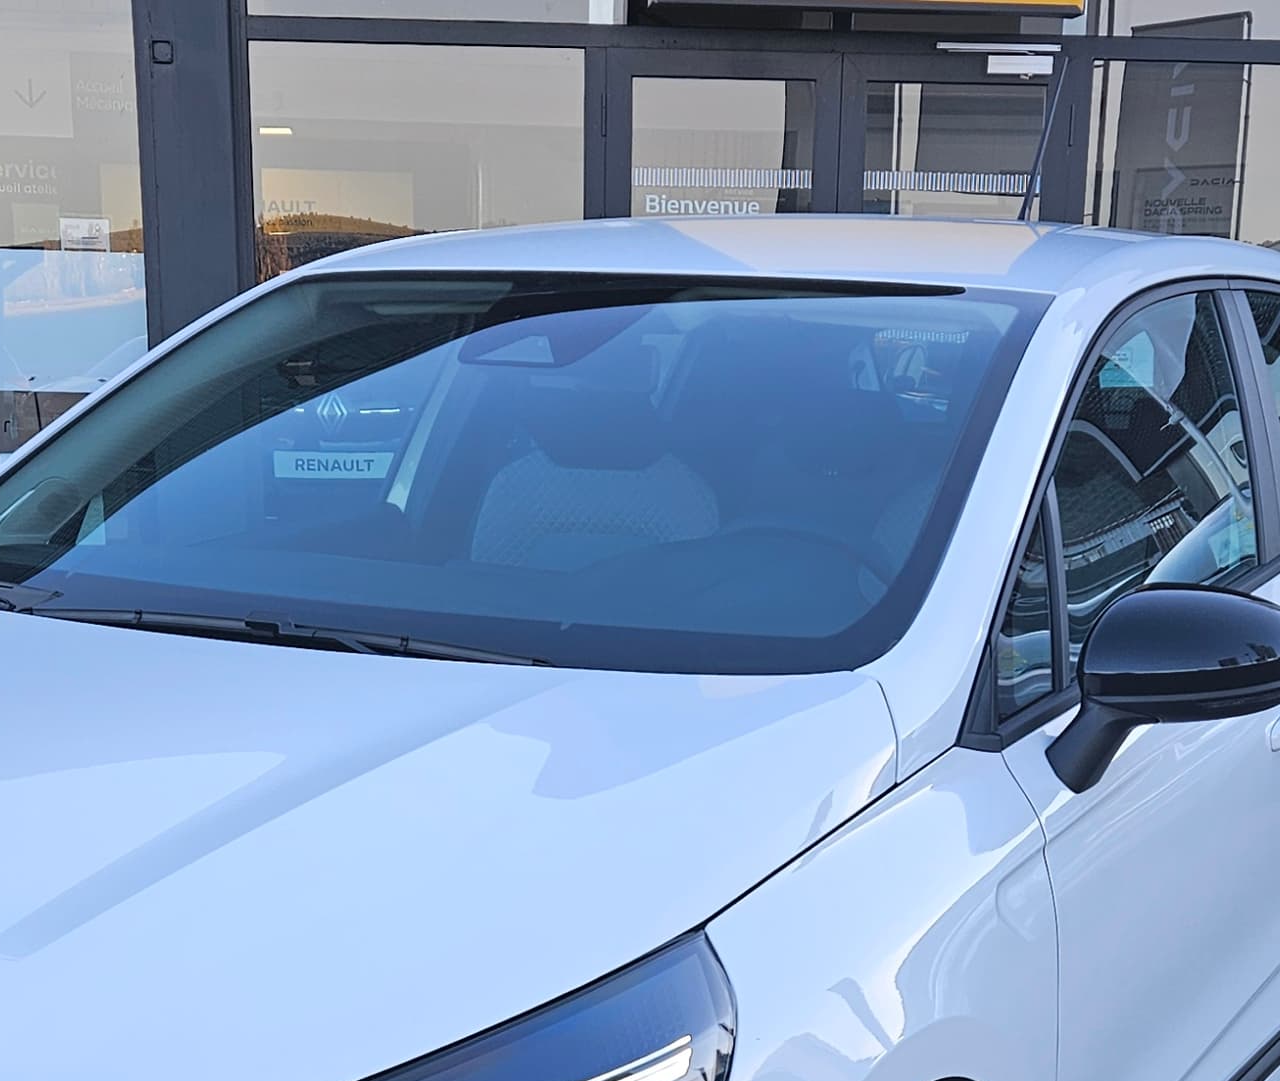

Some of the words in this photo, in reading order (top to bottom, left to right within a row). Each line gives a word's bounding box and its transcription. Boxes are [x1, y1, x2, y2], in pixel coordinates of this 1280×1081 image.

[645, 194, 760, 215] Bienvenue
[1144, 197, 1207, 207] NOUVELLE
[1179, 206, 1223, 215] SPRING
[295, 458, 375, 472] RENAULT
